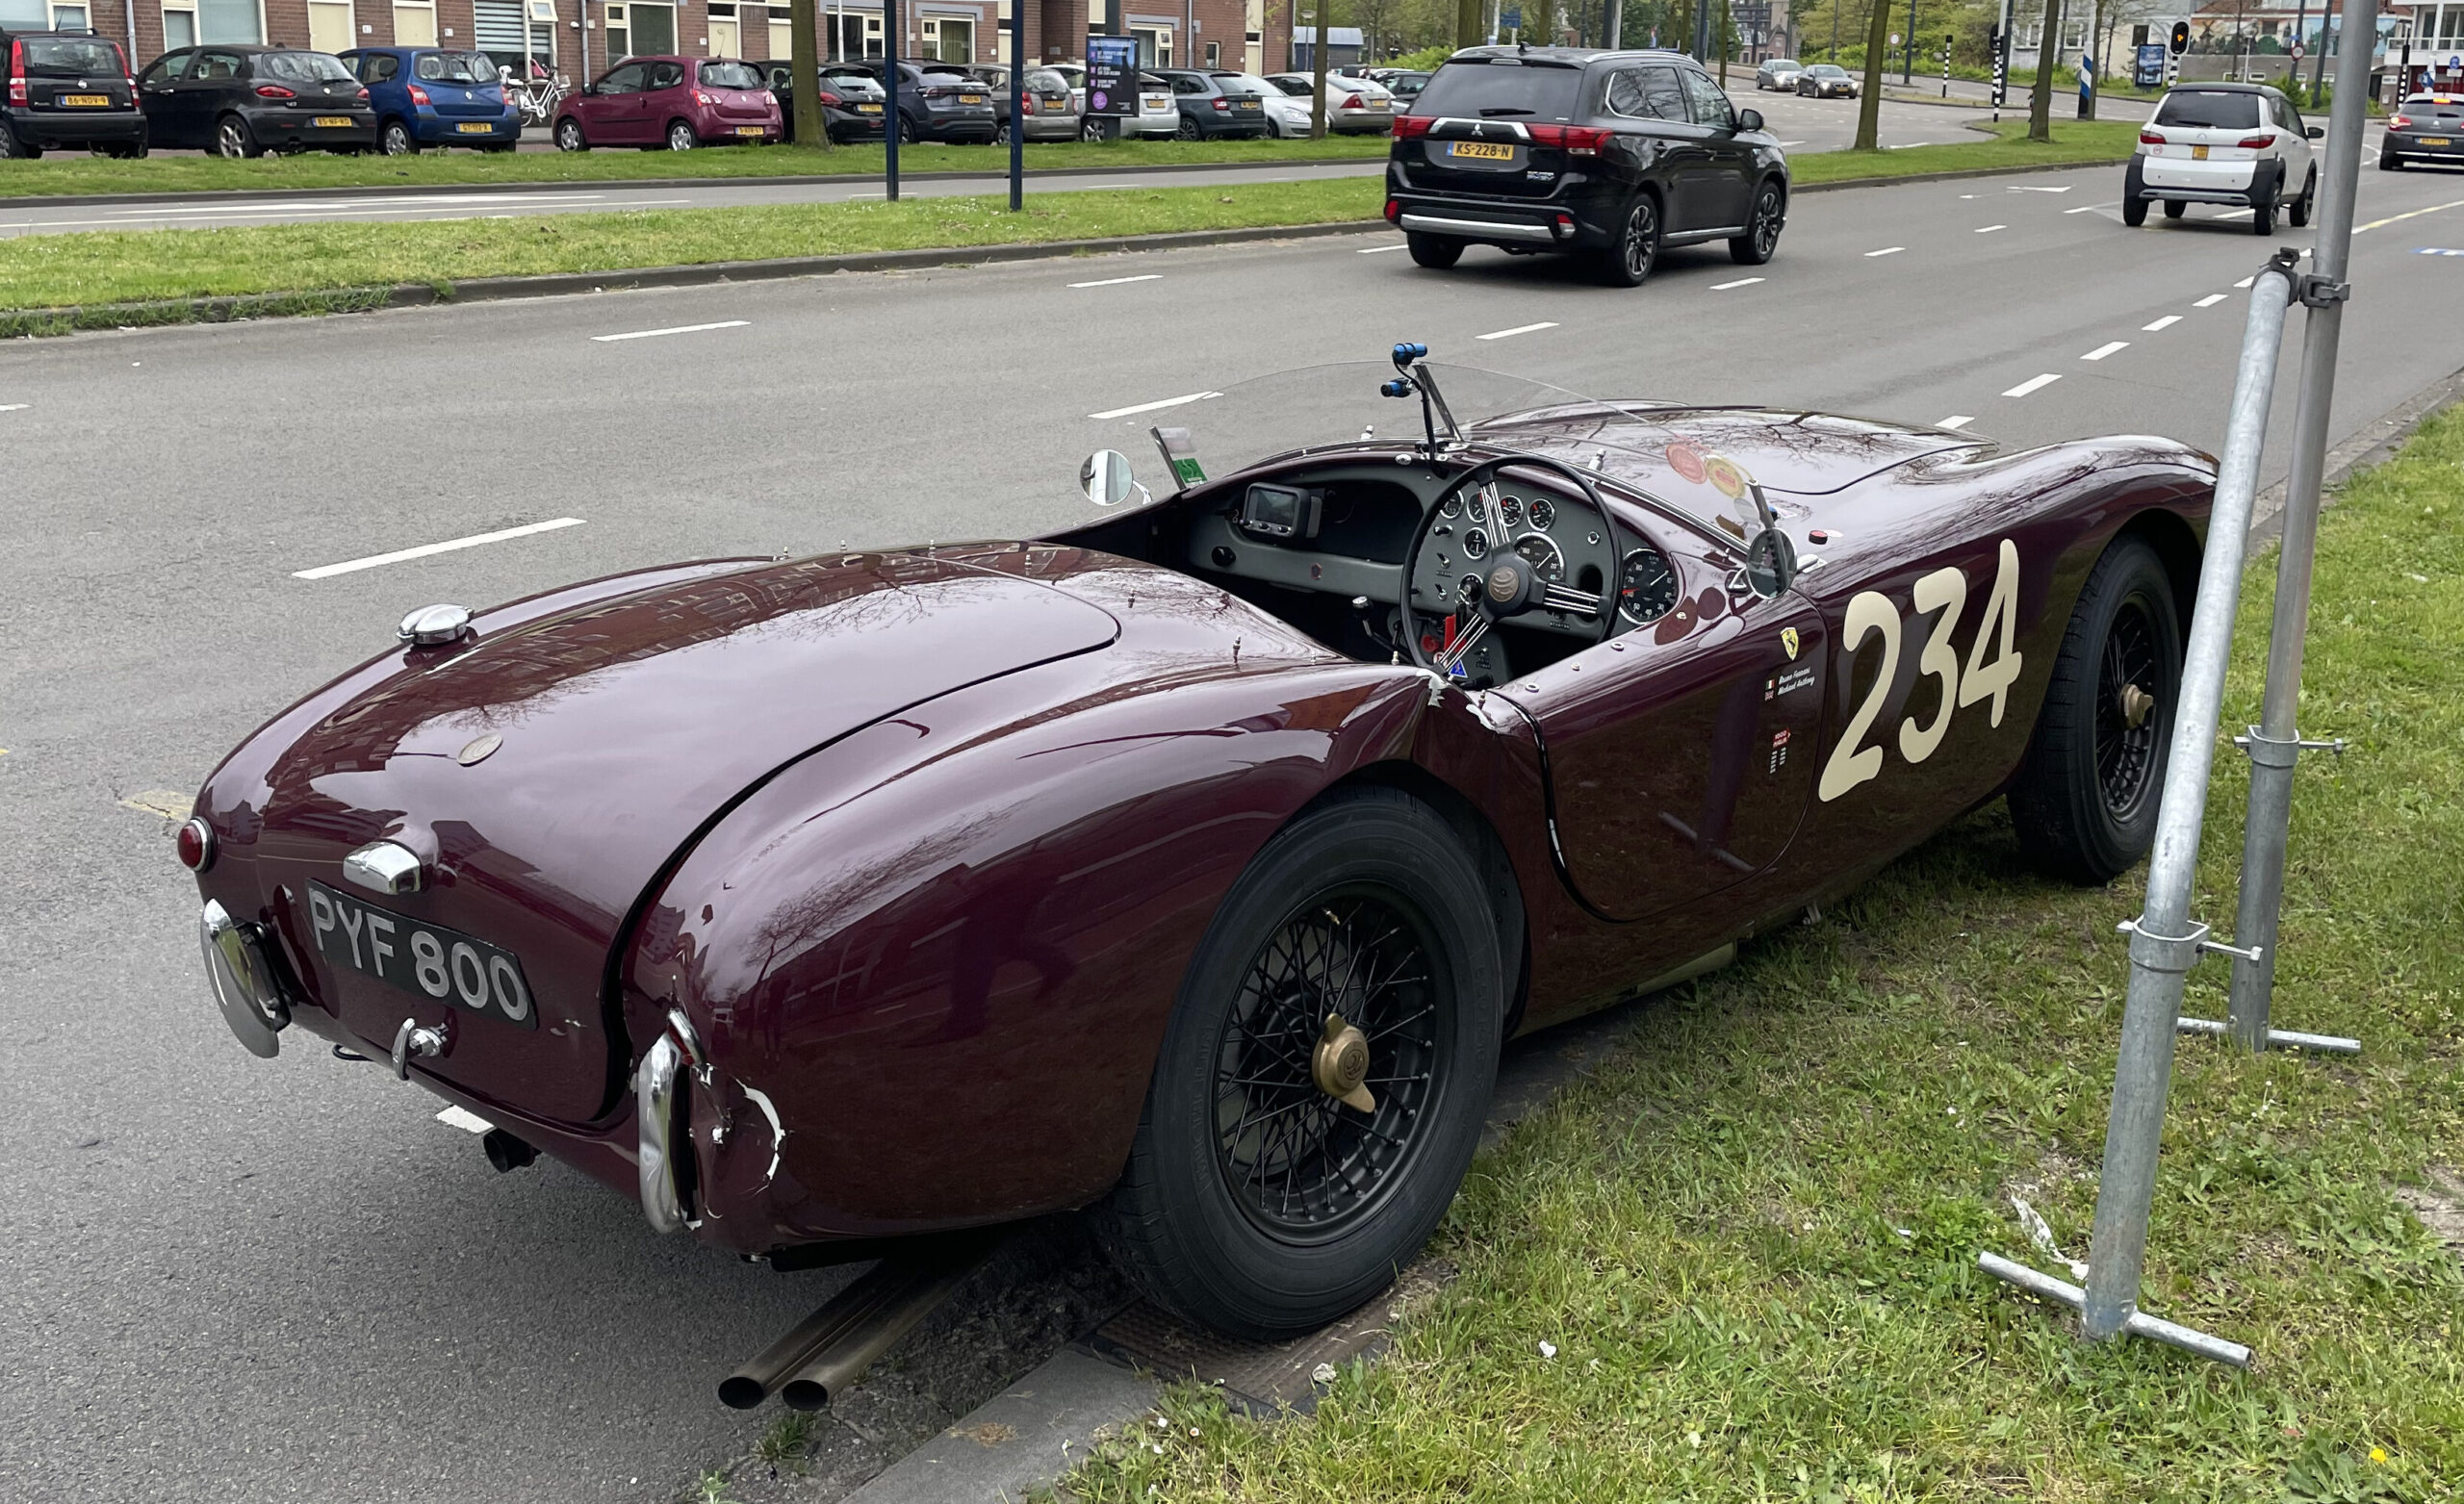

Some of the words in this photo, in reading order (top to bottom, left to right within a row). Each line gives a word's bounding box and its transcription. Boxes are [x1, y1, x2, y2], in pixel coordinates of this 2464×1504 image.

[1455, 142, 1510, 158] KS-228-N
[1817, 538, 2023, 803] 234
[308, 887, 396, 978] PYF
[410, 930, 528, 1022] 800
